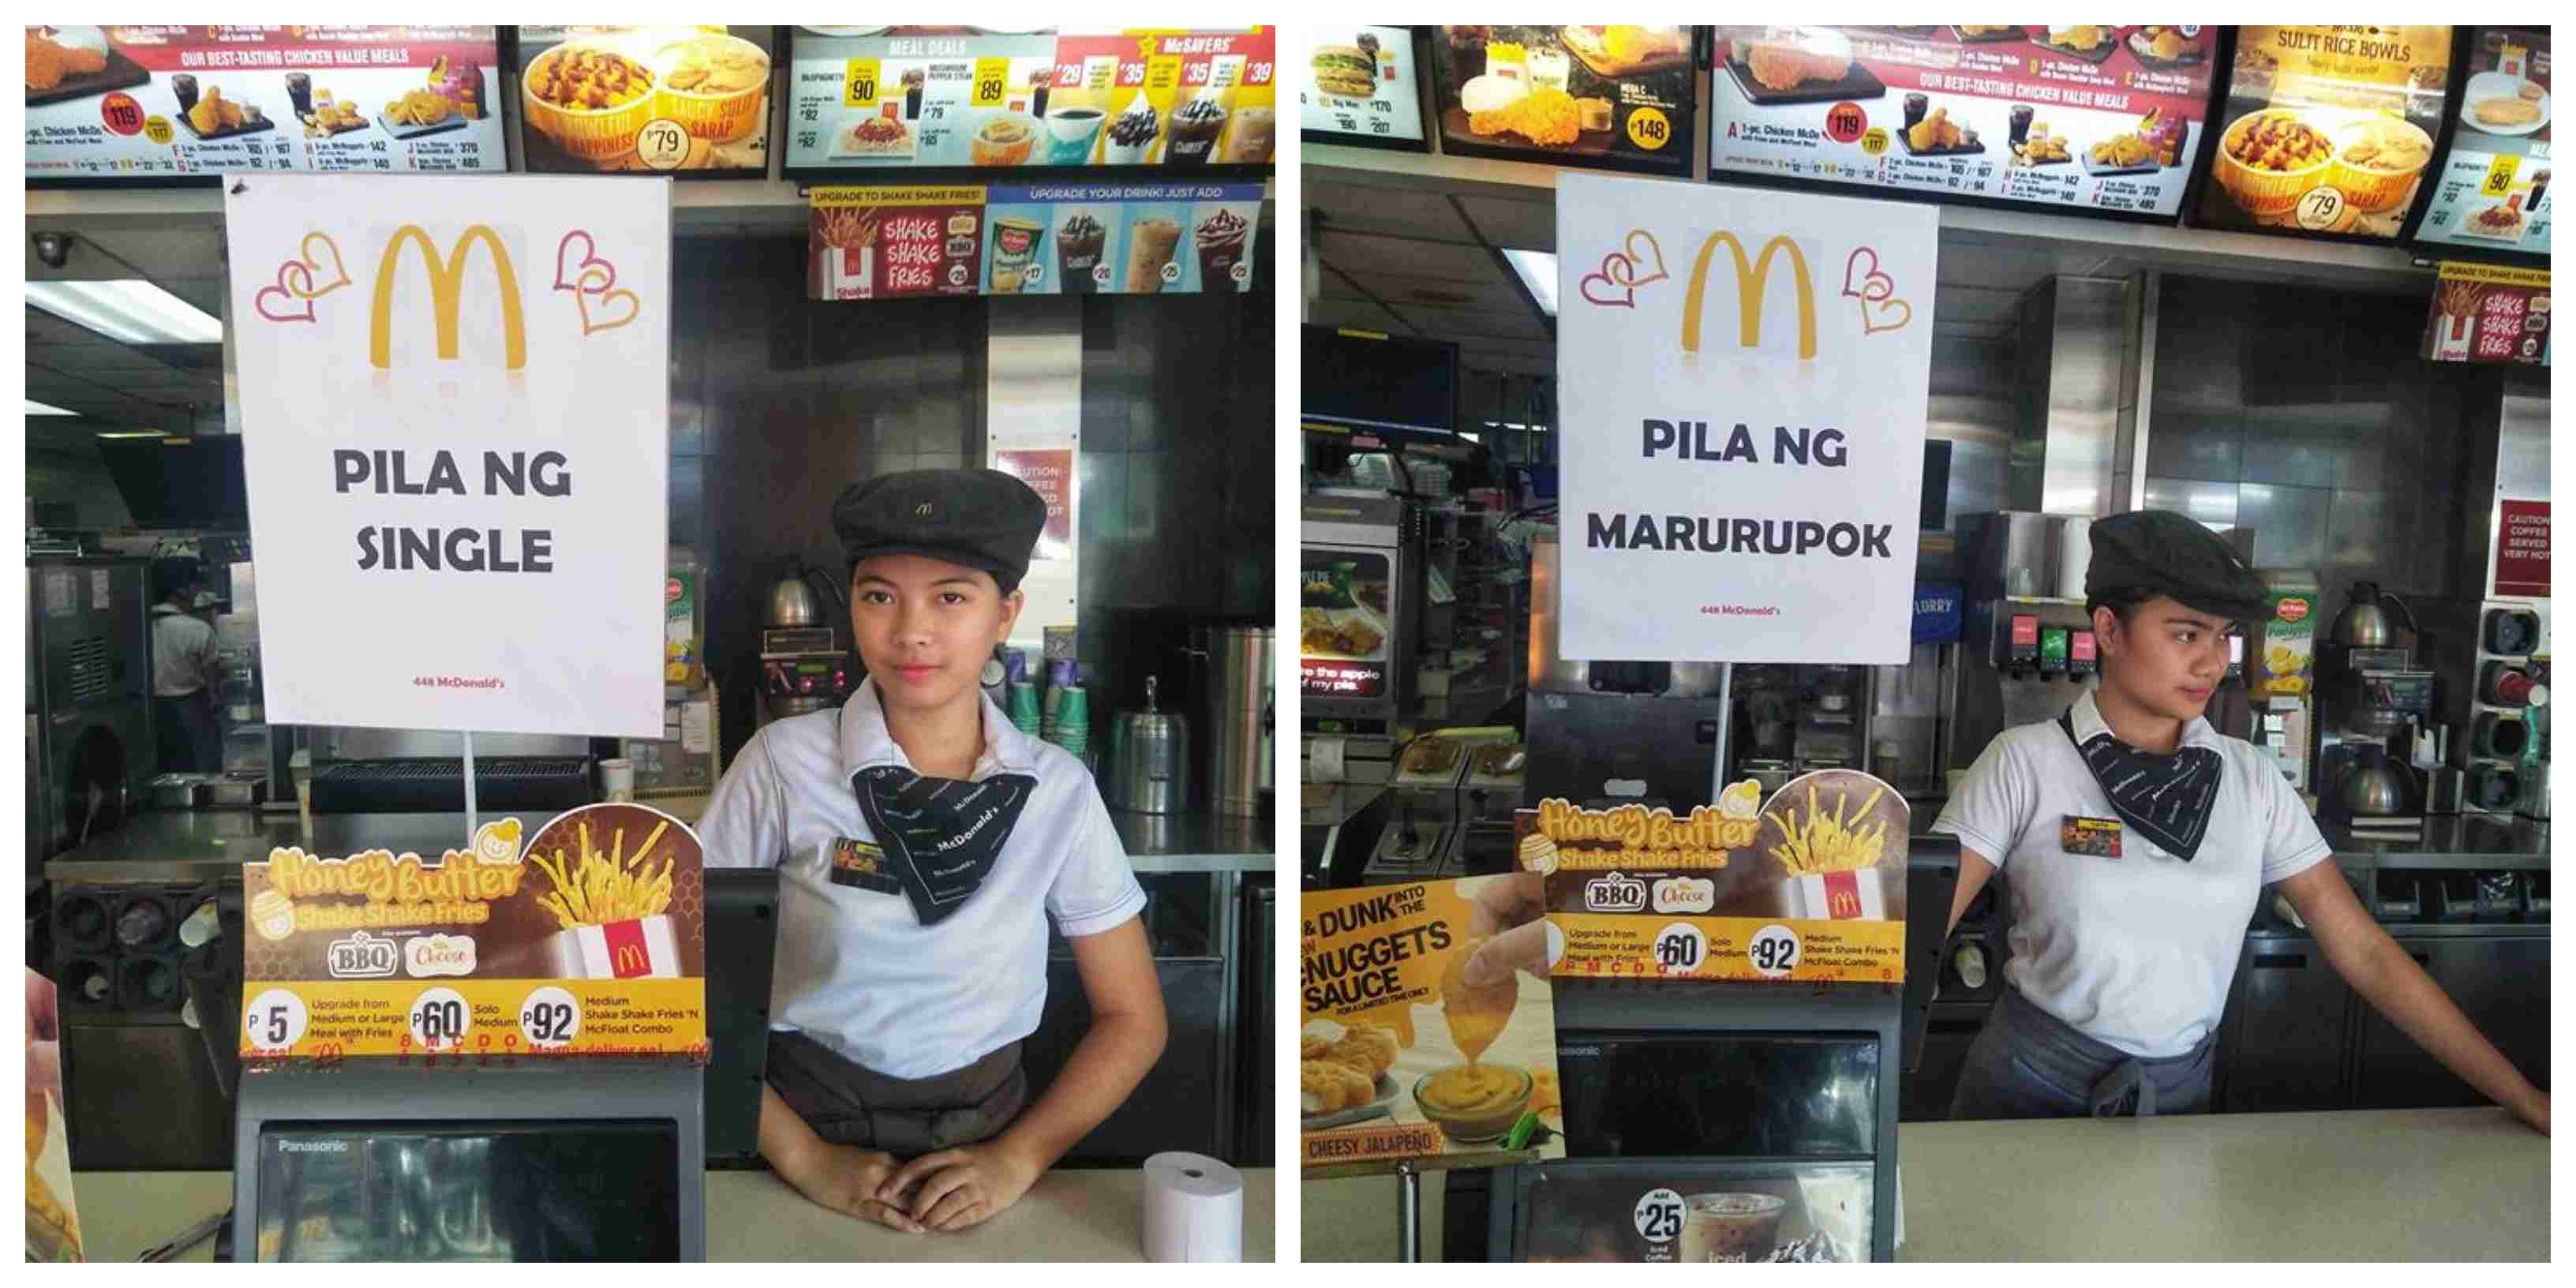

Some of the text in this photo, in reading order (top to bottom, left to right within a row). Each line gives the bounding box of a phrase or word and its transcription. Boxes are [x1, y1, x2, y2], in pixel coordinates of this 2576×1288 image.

[889, 39, 967, 56] MEAL DEALS
[2278, 32, 2412, 62] SULIT RICE BOWLS
[181, 48, 409, 66] OUR BEST-TASTING CHICKEN VALUE MEALS
[1919, 73, 2129, 110] OUR BEST-TASTING CHICKEN VALUE MEALS
[1728, 122, 1736, 138] A
[1763, 125, 1795, 137] Chicken
[1797, 126, 1820, 138] McDo
[815, 190, 862, 202] UPGRADE
[1030, 188, 1086, 199] UPGRADE
[1088, 188, 1121, 198] YOUR
[1166, 187, 1194, 197] JUST
[1197, 187, 1223, 197] ADD
[885, 217, 940, 240] SHAKE
[887, 242, 941, 264] SHAKE
[887, 267, 934, 289] FRIES
[2486, 293, 2525, 315] SHAKE
[2482, 315, 2522, 336] SHAKE
[2479, 335, 2514, 354] FRIES
[1642, 418, 1848, 467] PILA NG
[333, 448, 572, 498] PILA NG
[1587, 512, 1893, 559] MARURUPOK
[2510, 526, 2548, 537] COFFEE
[355, 525, 554, 574] SINGLE
[2509, 537, 2548, 548] SERVED
[2503, 549, 2528, 559] VERY
[1722, 604, 1780, 616] McDonald's
[436, 675, 506, 690] McDonald's
[1317, 667, 1380, 683] the apple
[1312, 681, 1331, 691] my
[1542, 808, 1758, 849] Honey Butter
[1560, 848, 1727, 867] Shake Shake Fries
[272, 849, 526, 901] Honey Butter
[1593, 886, 1639, 905] BBQ
[1661, 886, 1705, 904] Cheese
[297, 902, 490, 927] Shake Shake Fries
[1319, 894, 1398, 938] DUNK
[1394, 885, 1425, 904] INTO
[1400, 899, 1426, 916] THE
[1804, 934, 1843, 942] Medium
[337, 947, 390, 969] BBQ
[1304, 966, 1403, 1013] SAUCE
[312, 999, 390, 1013] Upgrade from
[474, 1004, 500, 1014] Solo
[585, 996, 630, 1005] Medium
[311, 1013, 406, 1025] Medium or Large
[474, 1017, 519, 1028] Medium
[585, 1009, 619, 1019] Shake
[621, 1009, 653, 1019] Shake
[657, 1009, 684, 1019] Fries
[268, 1005, 288, 1044] 5
[310, 1028, 393, 1038] Meal with Fries
[585, 1024, 673, 1034] McFloat Combo
[278, 1140, 348, 1152] Panasonic
[1309, 1139, 1358, 1158] CHEESY
